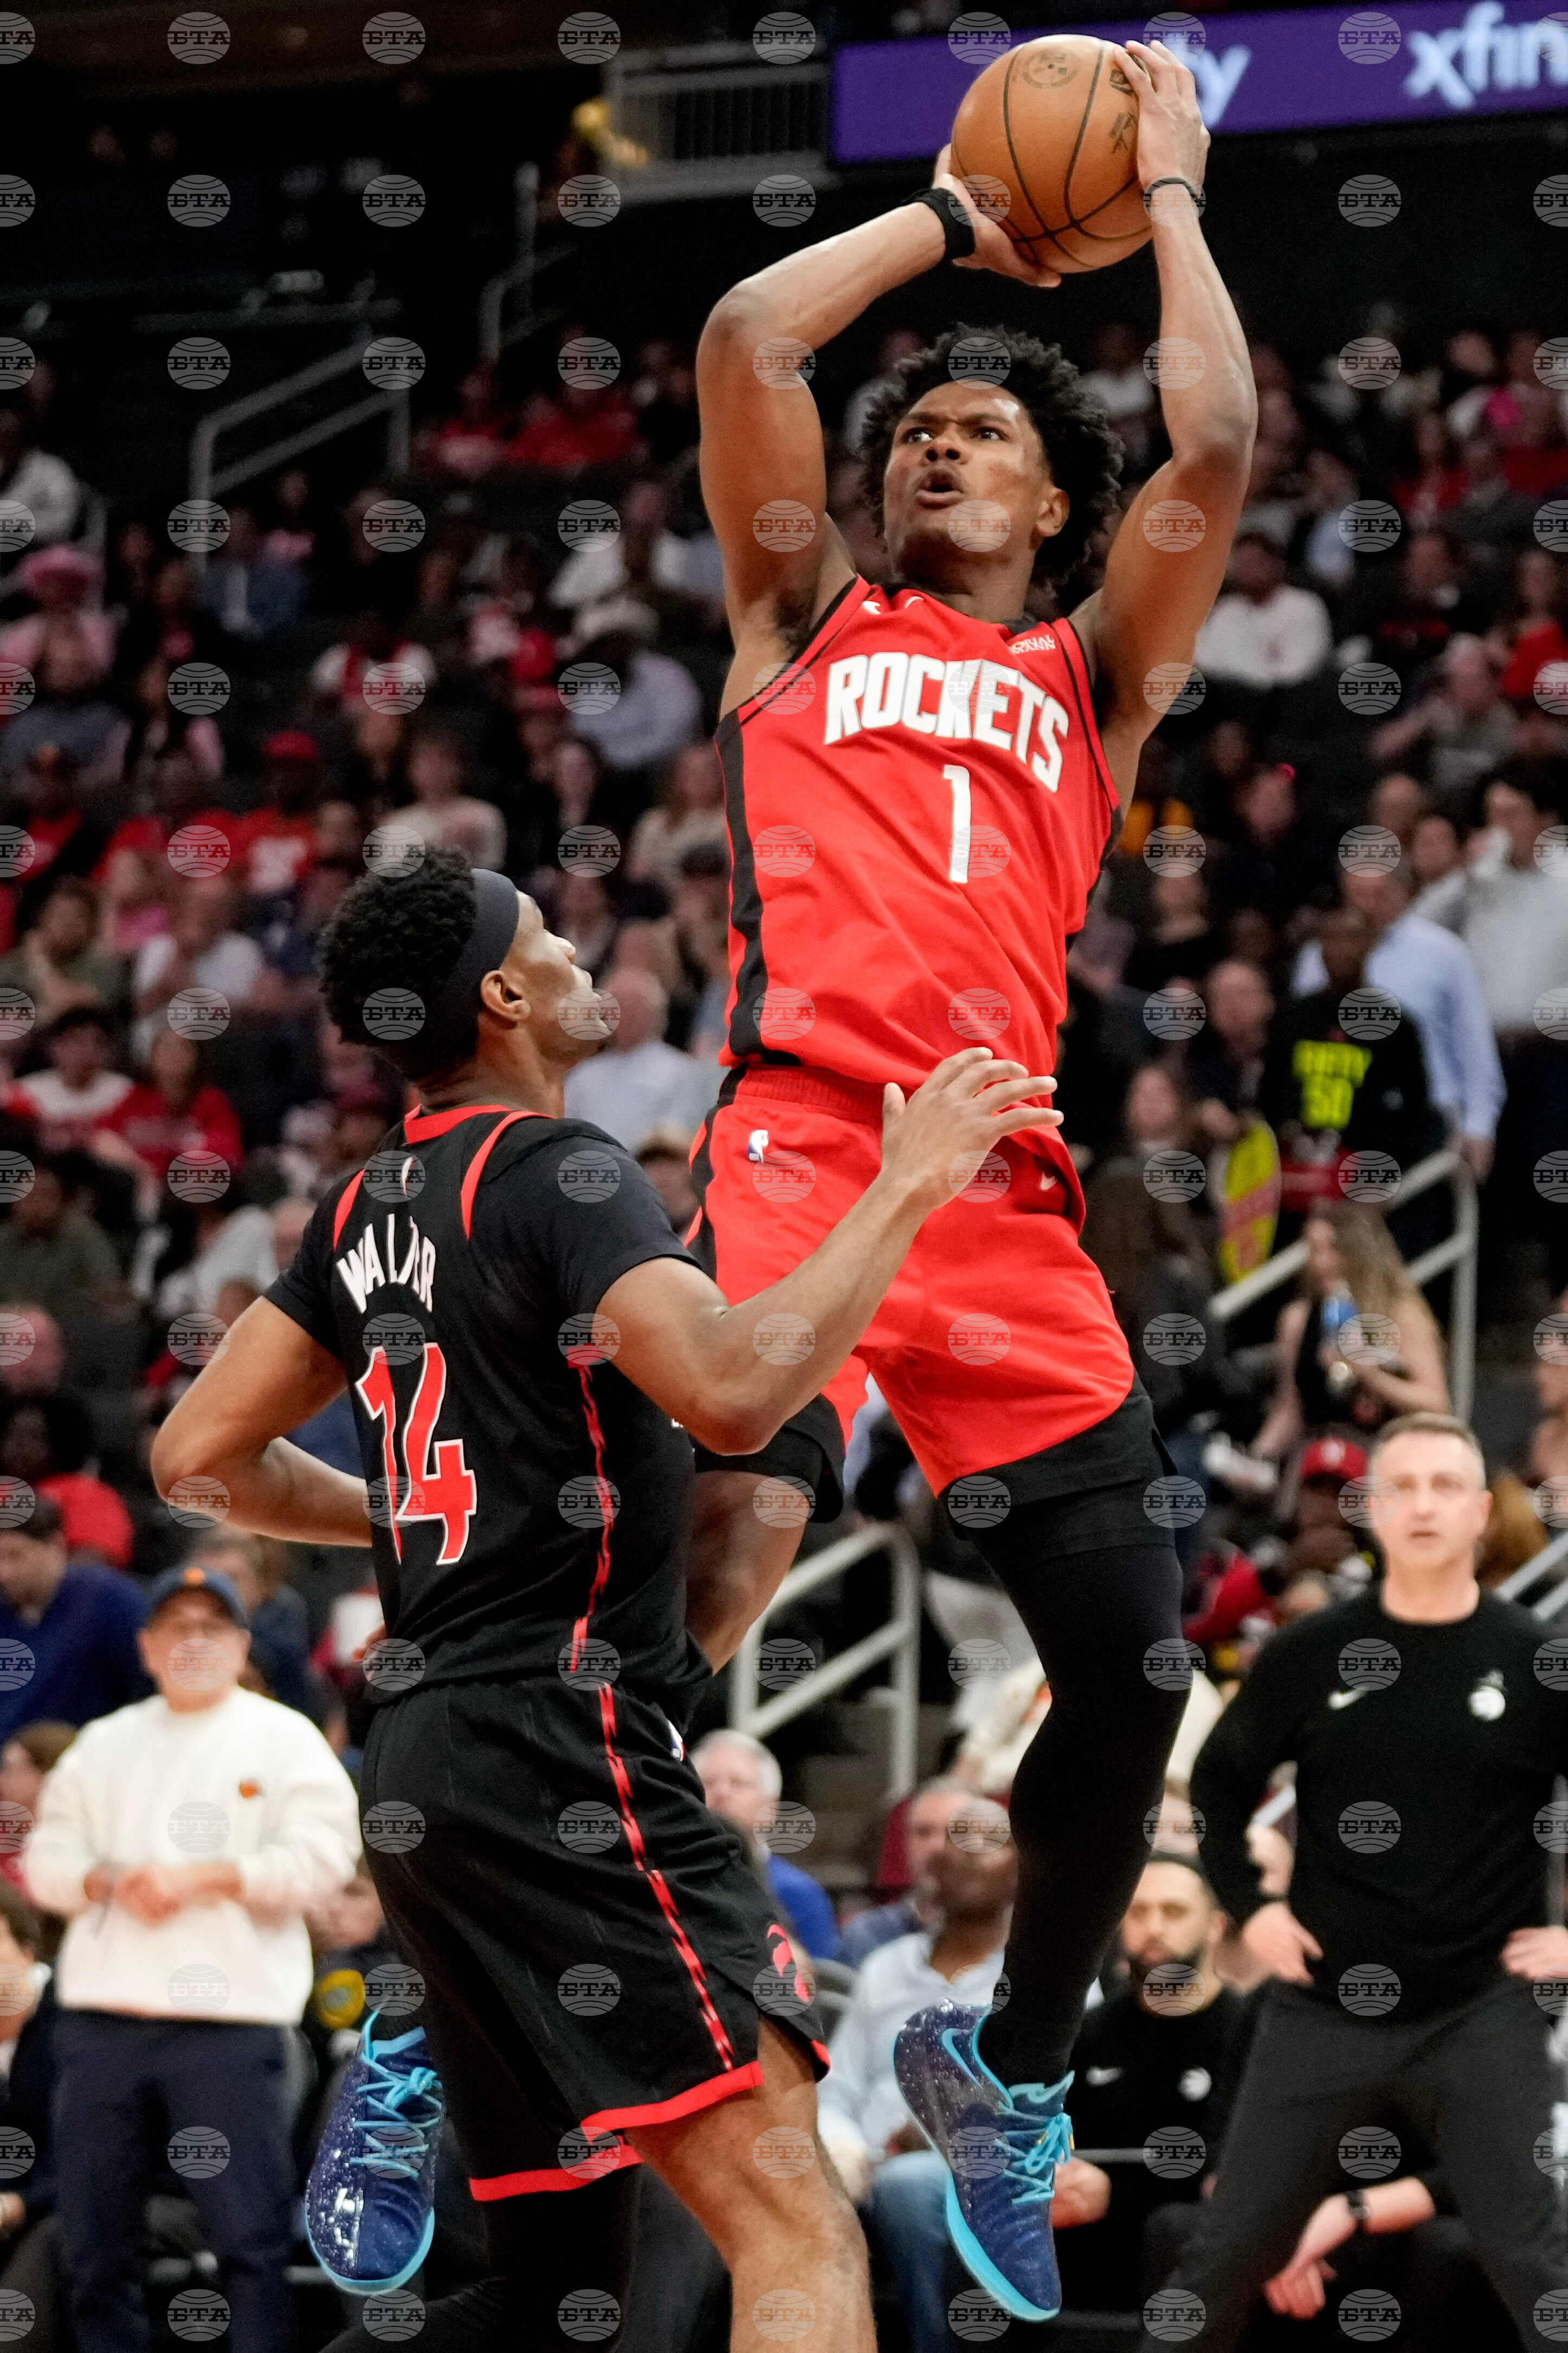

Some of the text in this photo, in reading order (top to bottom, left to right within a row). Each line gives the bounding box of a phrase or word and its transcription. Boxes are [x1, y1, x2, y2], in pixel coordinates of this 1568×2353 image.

[824, 652, 1069, 793] ROCKETS
[943, 764, 971, 883] 1
[356, 1342, 477, 1565] 14
